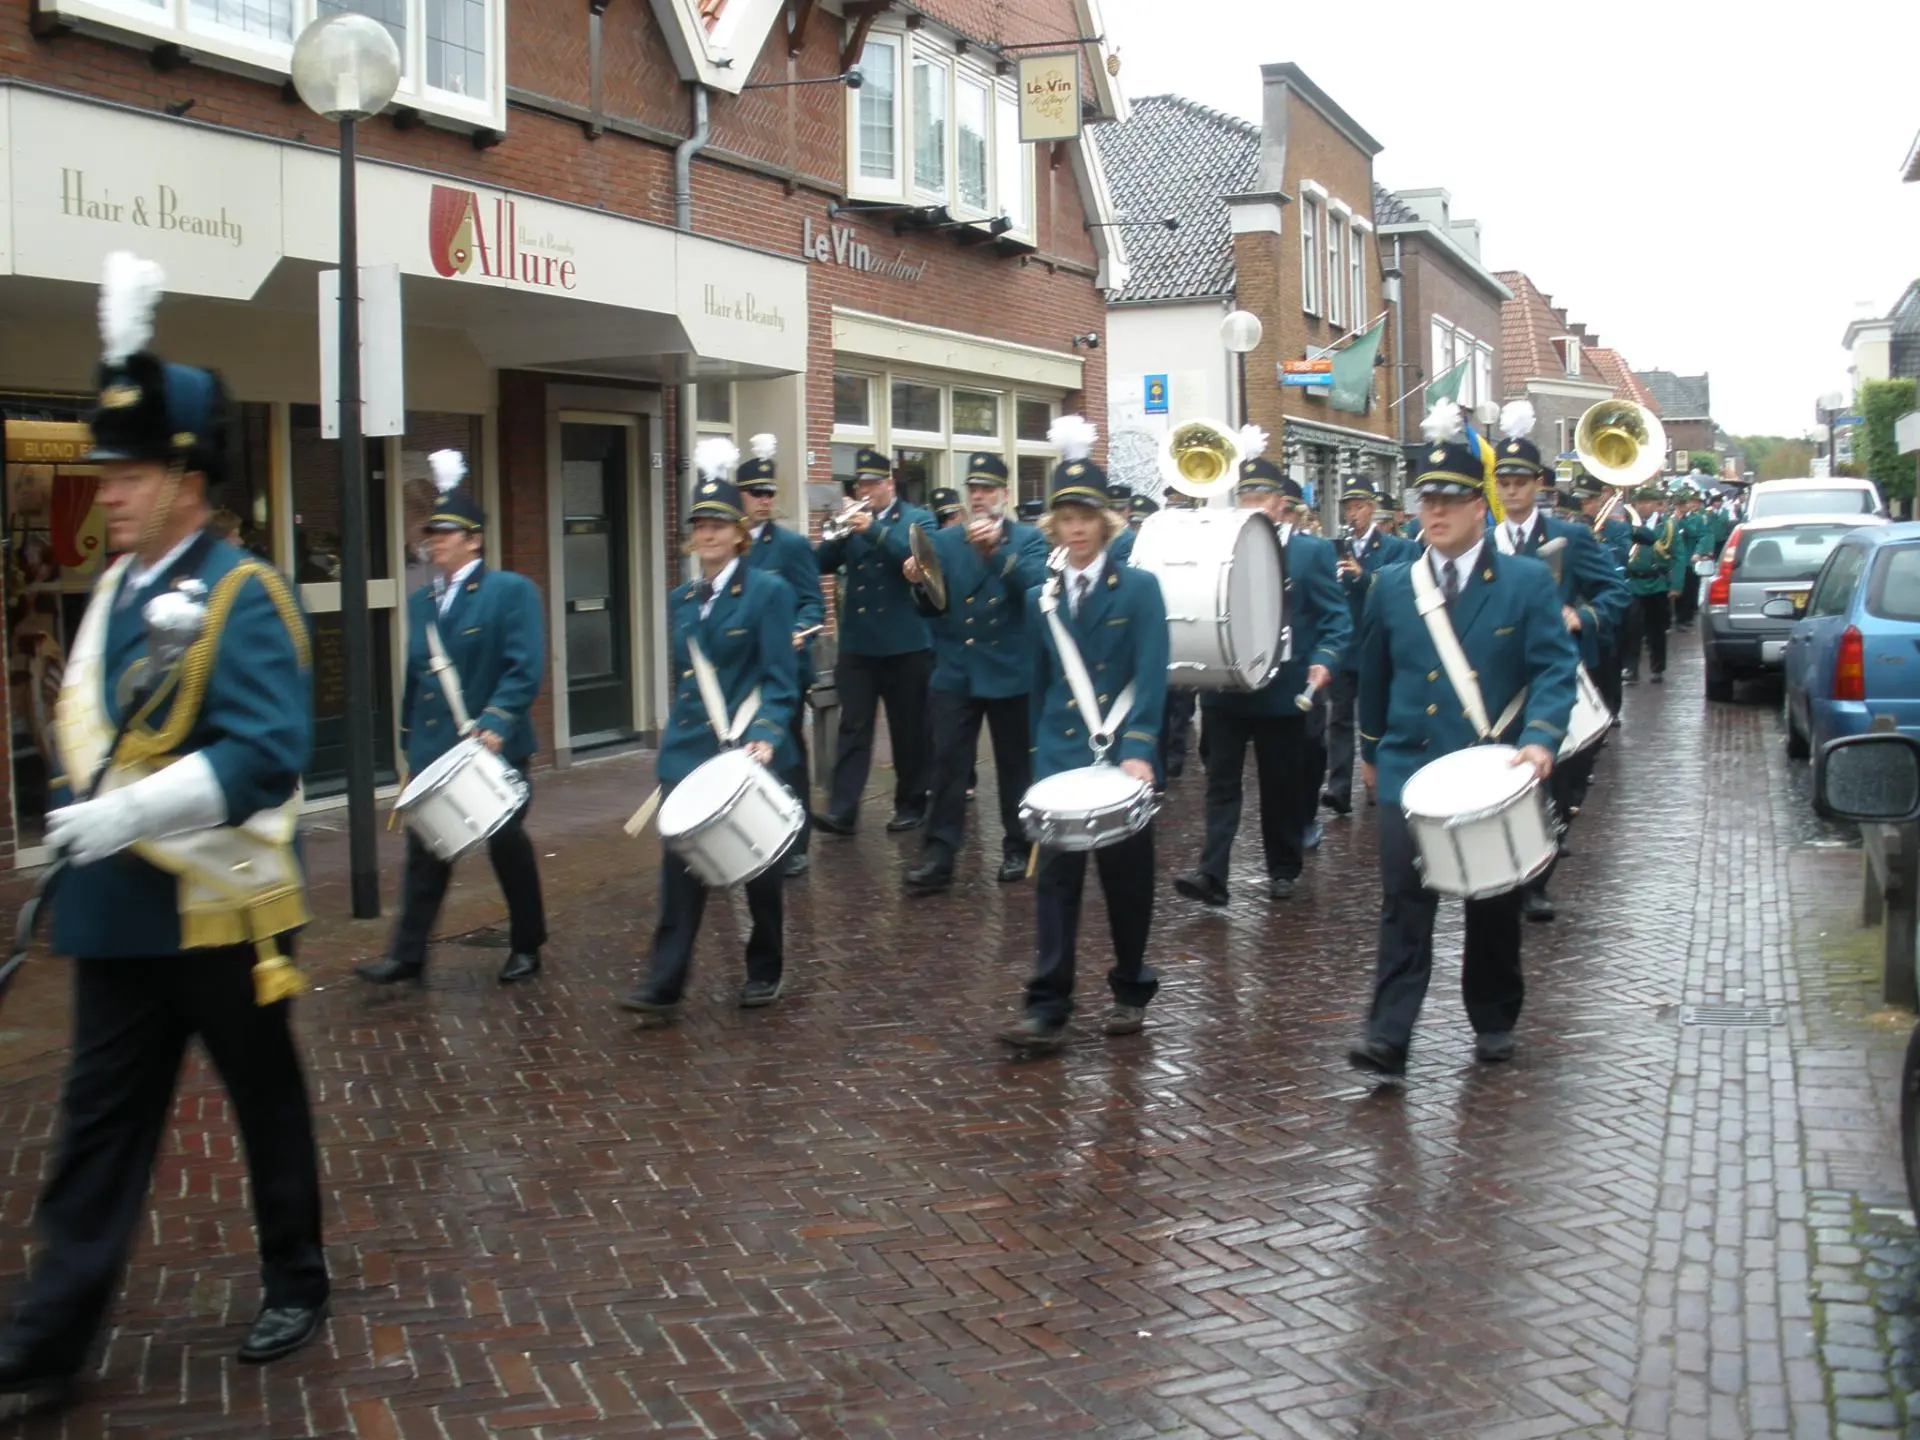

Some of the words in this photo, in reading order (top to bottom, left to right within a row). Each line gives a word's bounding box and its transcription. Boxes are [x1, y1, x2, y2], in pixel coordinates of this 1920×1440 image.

[1027, 82, 1042, 94] Le
[1047, 78, 1071, 92] Vin
[60, 166, 124, 223] Hair
[132, 196, 150, 227] &
[158, 184, 243, 248] Beauty
[470, 190, 577, 290] Allure
[704, 283, 731, 318] Hair
[746, 292, 784, 332] Beauty
[24, 441, 74, 458] BLOND
